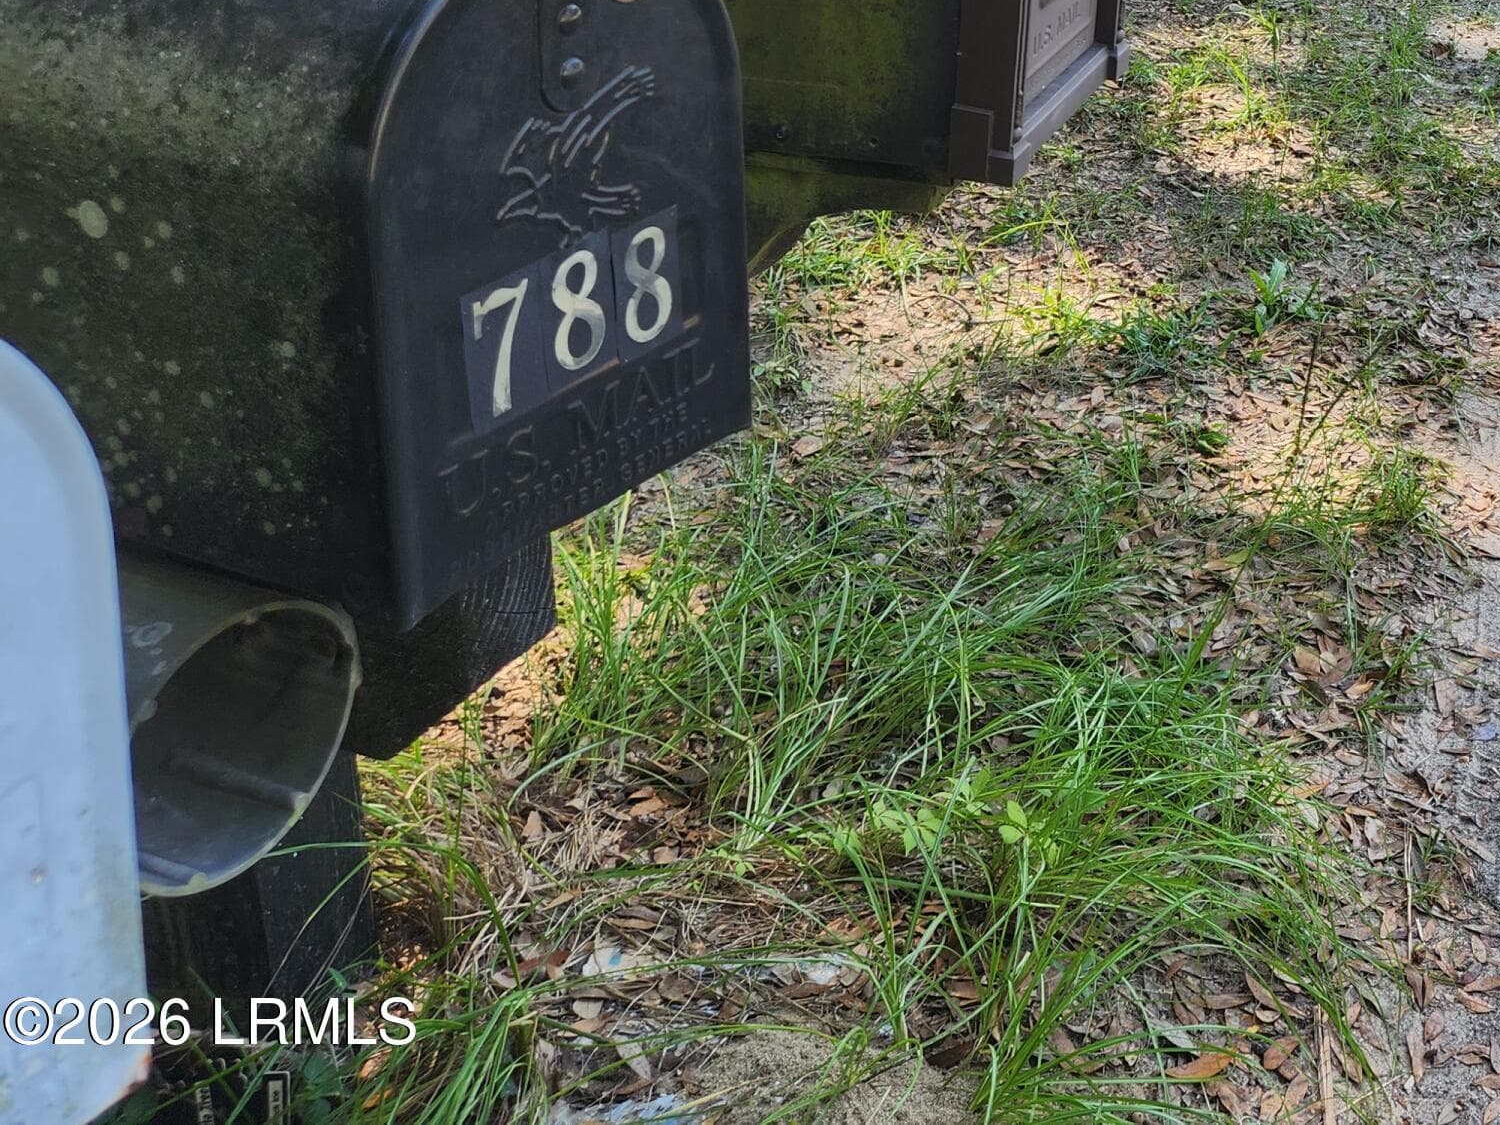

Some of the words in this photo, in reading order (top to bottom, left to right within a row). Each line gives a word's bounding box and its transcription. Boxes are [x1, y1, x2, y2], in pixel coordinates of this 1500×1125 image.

[1057, 0, 1081, 36] MAIL
[473, 225, 673, 418] 788
[438, 425, 551, 517] U.S.
[567, 338, 715, 455] MAIL
